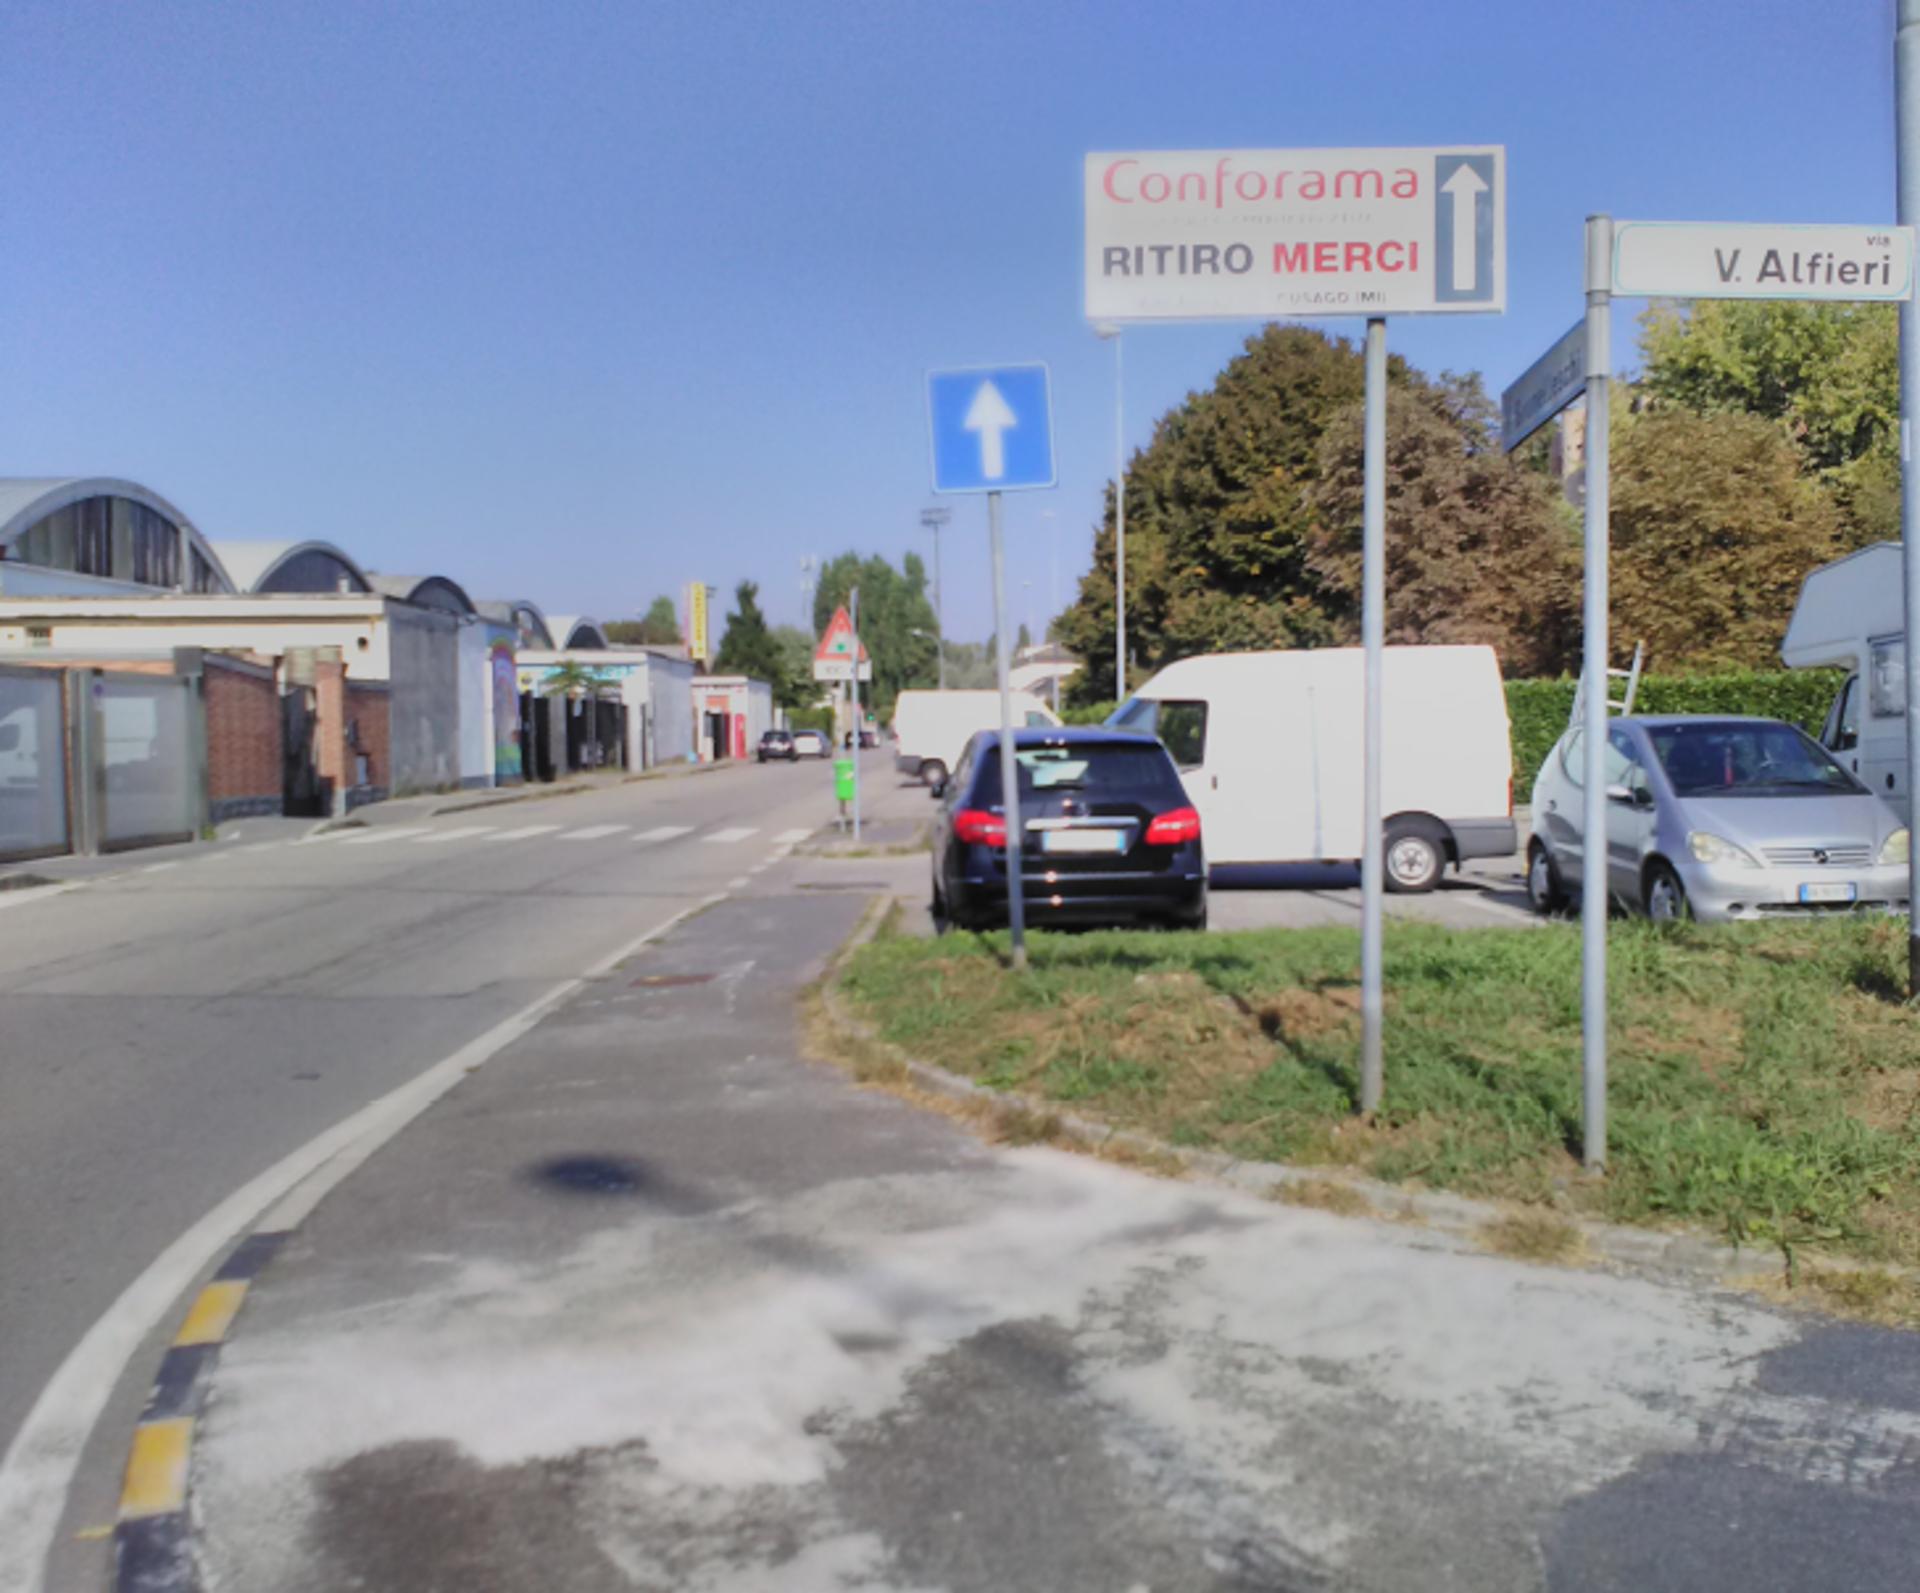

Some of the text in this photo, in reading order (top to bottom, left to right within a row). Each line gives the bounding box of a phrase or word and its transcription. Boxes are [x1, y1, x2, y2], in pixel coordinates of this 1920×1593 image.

[1102, 157, 1419, 209] Conforama
[1102, 240, 1419, 276] RITIRO MERCI
[1866, 234, 1891, 247] via
[1714, 248, 1891, 286] V. Alfieri
